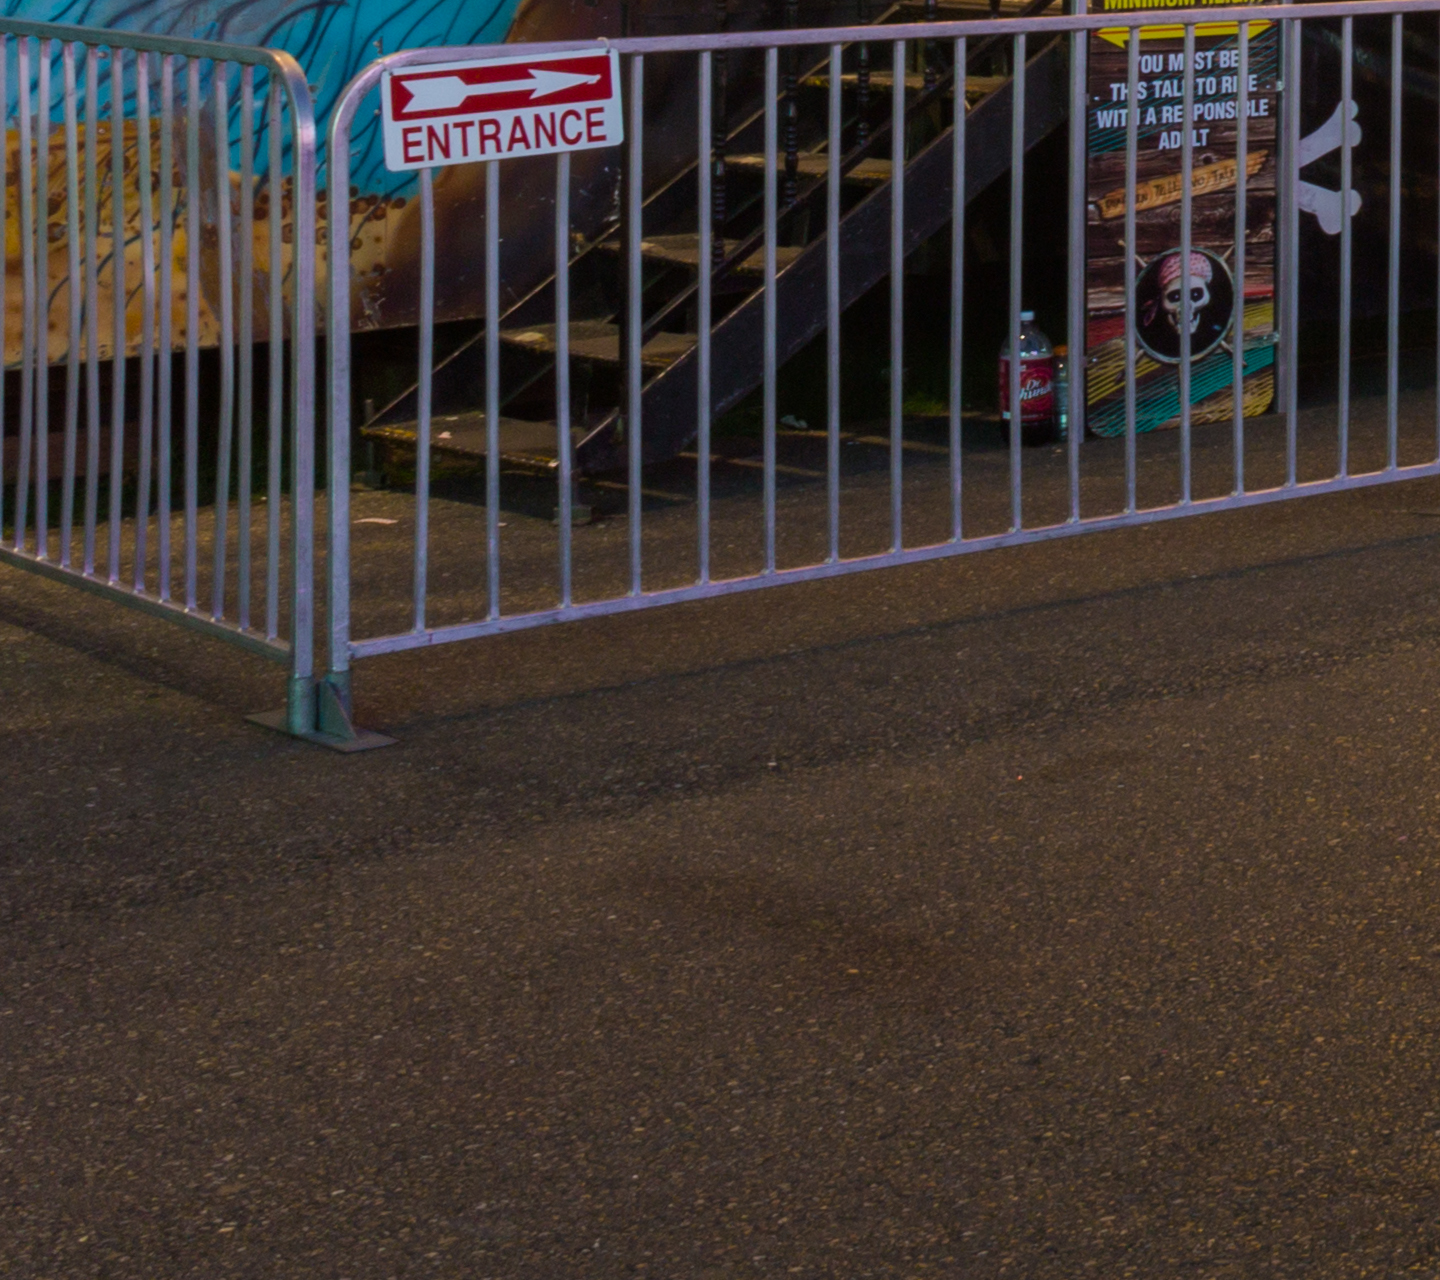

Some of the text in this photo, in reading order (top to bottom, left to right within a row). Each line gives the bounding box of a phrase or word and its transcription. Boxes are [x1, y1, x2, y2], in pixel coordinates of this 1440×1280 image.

[1137, 49, 1240, 73] OU MST BE
[1110, 81, 1147, 102] THS
[1195, 76, 1217, 96] TO
[1221, 74, 1258, 93] RIE
[1145, 107, 1157, 125] A
[401, 106, 607, 164] ENTRANCE
[1158, 128, 1210, 151] ADLT
